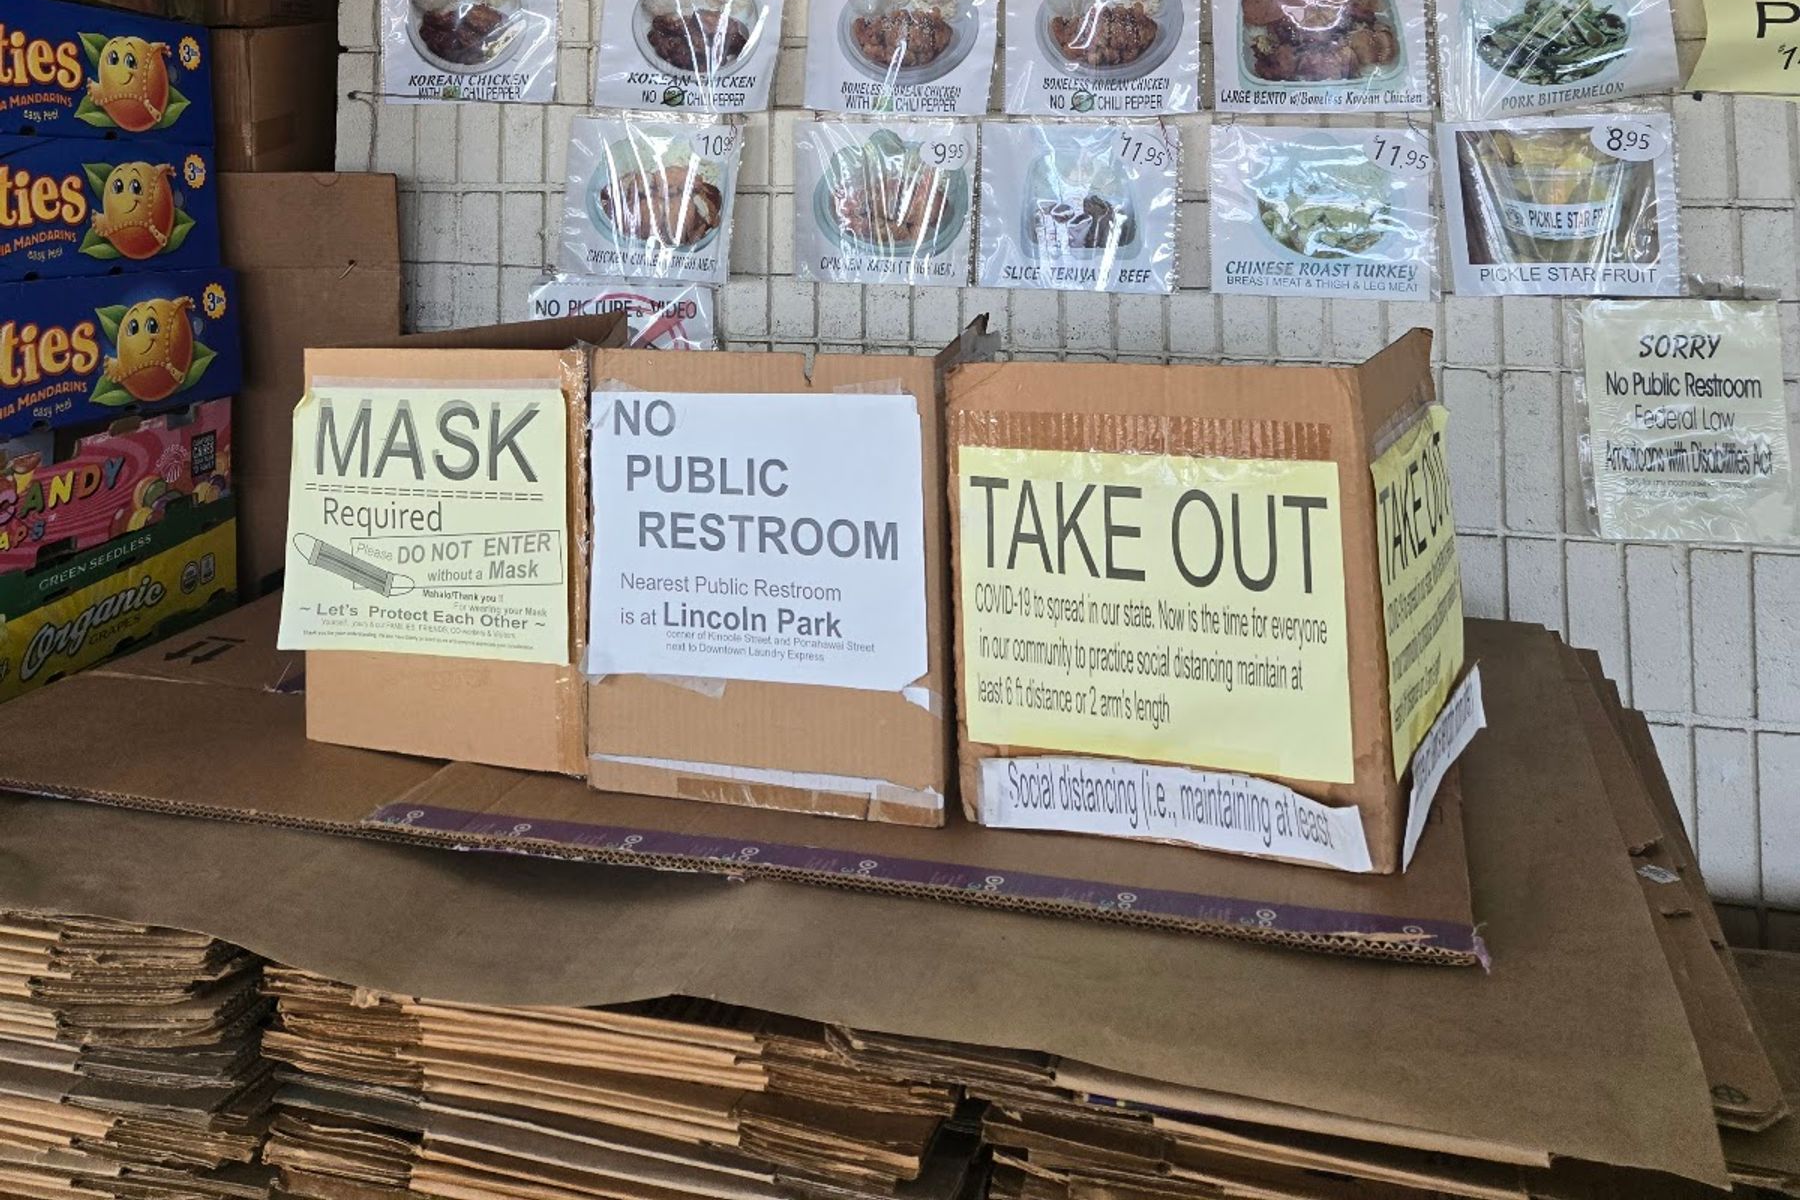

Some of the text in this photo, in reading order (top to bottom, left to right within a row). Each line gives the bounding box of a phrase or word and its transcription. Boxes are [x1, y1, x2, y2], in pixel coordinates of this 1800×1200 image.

[408, 74, 529, 86] KOREAN CHICKEN
[418, 88, 440, 99] WITH
[487, 88, 521, 99] PEPPER
[10, 93, 72, 107] MANDARINS
[1050, 95, 1064, 109] NO
[1125, 95, 1163, 109] PEPPER
[1221, 89, 1250, 103] LARGE
[1254, 91, 1286, 104] BENTO
[1346, 92, 1379, 104] Korean
[1384, 92, 1422, 104] Chicken
[1501, 82, 1624, 110] PORK BITTERMELON
[1529, 210, 1590, 228] PICKLE STAR
[1226, 261, 1418, 280] CHINESE ROAST TURKEY
[1227, 276, 1418, 292] BREAST MEAT THIGH LEG MEAT
[1481, 267, 1656, 282] PICKLE STAR FRUIT
[536, 300, 697, 319] NO VIDEO
[1640, 334, 1721, 359] SORRY
[18, 382, 87, 410] MANDARINS
[1606, 371, 1761, 398] No Public Restroom
[613, 400, 676, 437] NO
[1635, 405, 1735, 431] Federal Law
[314, 398, 540, 482] MASK
[626, 454, 789, 497] PUBLIC
[324, 497, 442, 536] Required
[398, 533, 550, 564] DO NOT ENTER
[638, 511, 898, 560] RESTROOM
[970, 476, 1146, 582] TAKE
[1171, 489, 1327, 594] OUT
[39, 534, 152, 590] GREEN SEEDLESS
[428, 560, 538, 582] without a Mask
[621, 573, 841, 601] Nearest Public Restroom
[20, 576, 167, 681] Organic
[317, 603, 358, 616] Let's
[369, 606, 428, 622] Protect
[434, 611, 474, 626] Each
[480, 614, 528, 630] Other
[621, 602, 842, 638] is at Lincoln Park
[975, 583, 1327, 650] COVID-19 to spread in our state. Now is the time for everyone
[980, 628, 1303, 692] in our community to practice social distancing maintain at
[978, 672, 1170, 730] least 6 ft distance or 2 arm's length
[1008, 761, 1055, 808] Social
[1059, 766, 1138, 829] distancing
[1180, 776, 1271, 848] maintaining
[1275, 795, 1292, 836] at
[1294, 794, 1334, 849] least
